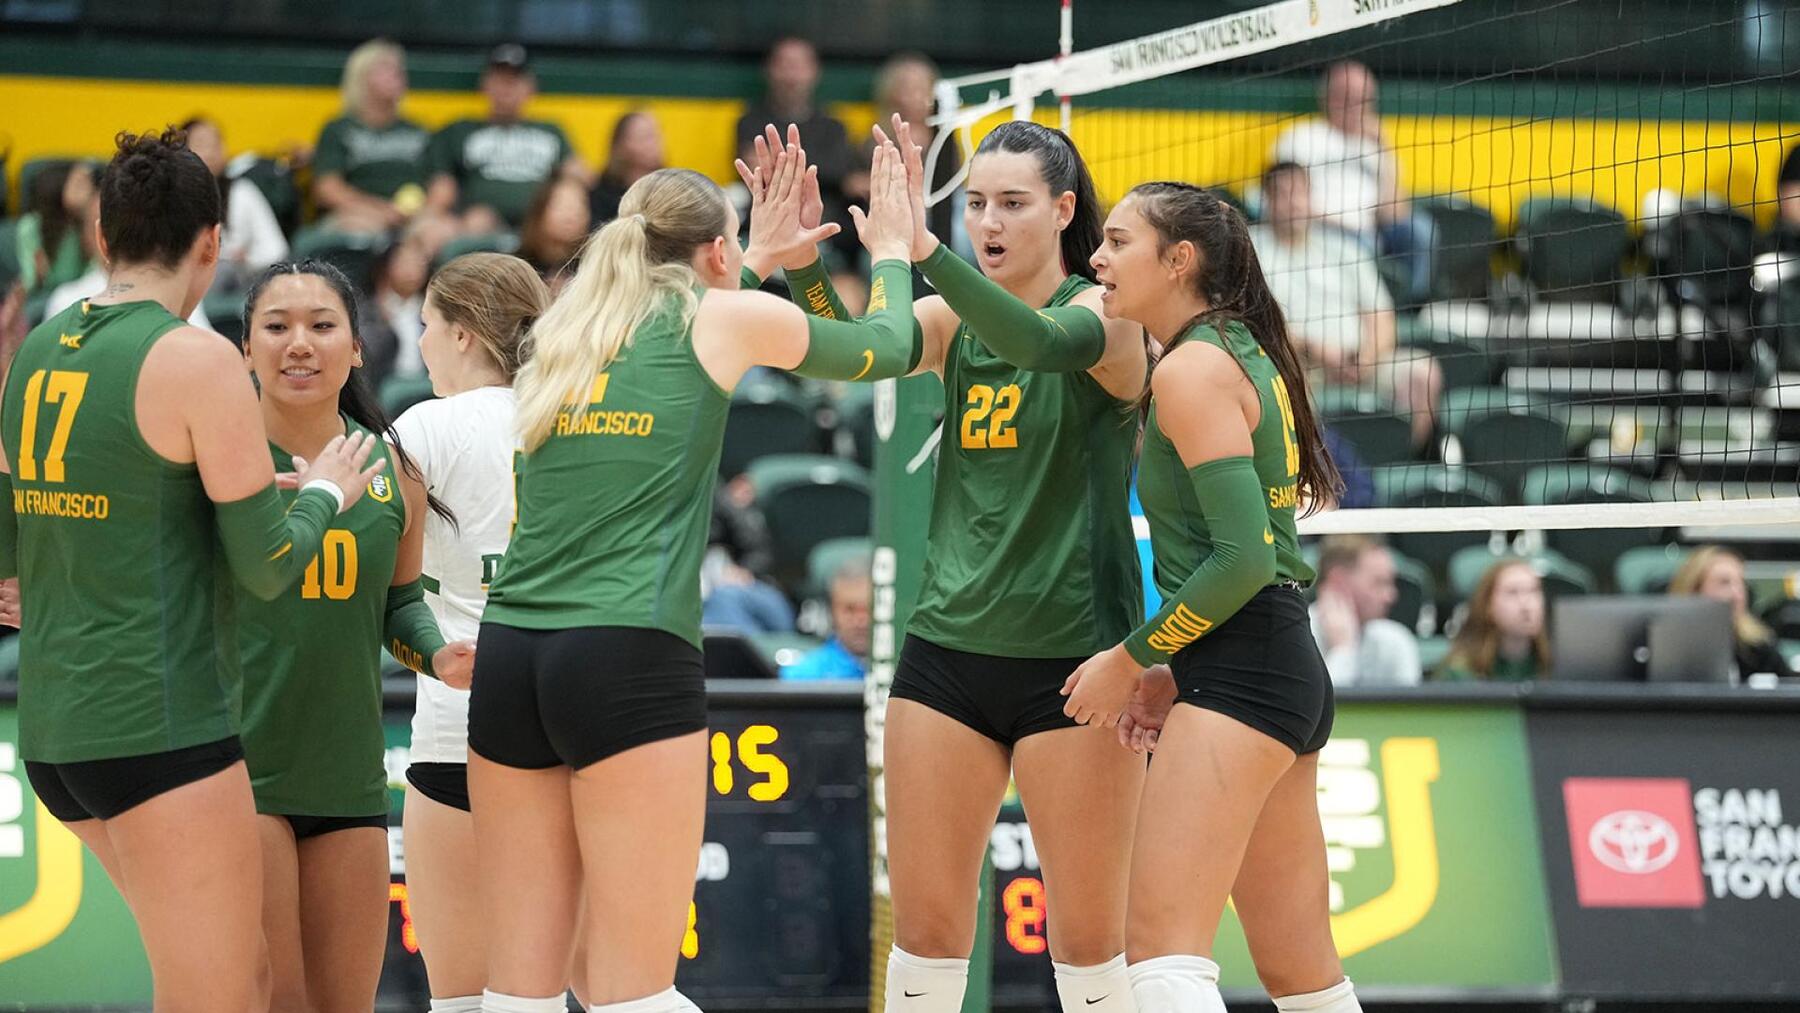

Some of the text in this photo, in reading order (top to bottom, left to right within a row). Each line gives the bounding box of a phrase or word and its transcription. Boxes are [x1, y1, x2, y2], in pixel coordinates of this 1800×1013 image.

[805, 281, 829, 312] TEAM
[18, 369, 90, 483] 17
[556, 410, 655, 437] RANCISCO
[961, 384, 1022, 449] 22
[26, 490, 109, 519] FRANCISCO
[301, 529, 359, 600] 10
[1147, 602, 1214, 655] DONS
[711, 725, 790, 802] 15
[1694, 787, 1782, 828] SAN
